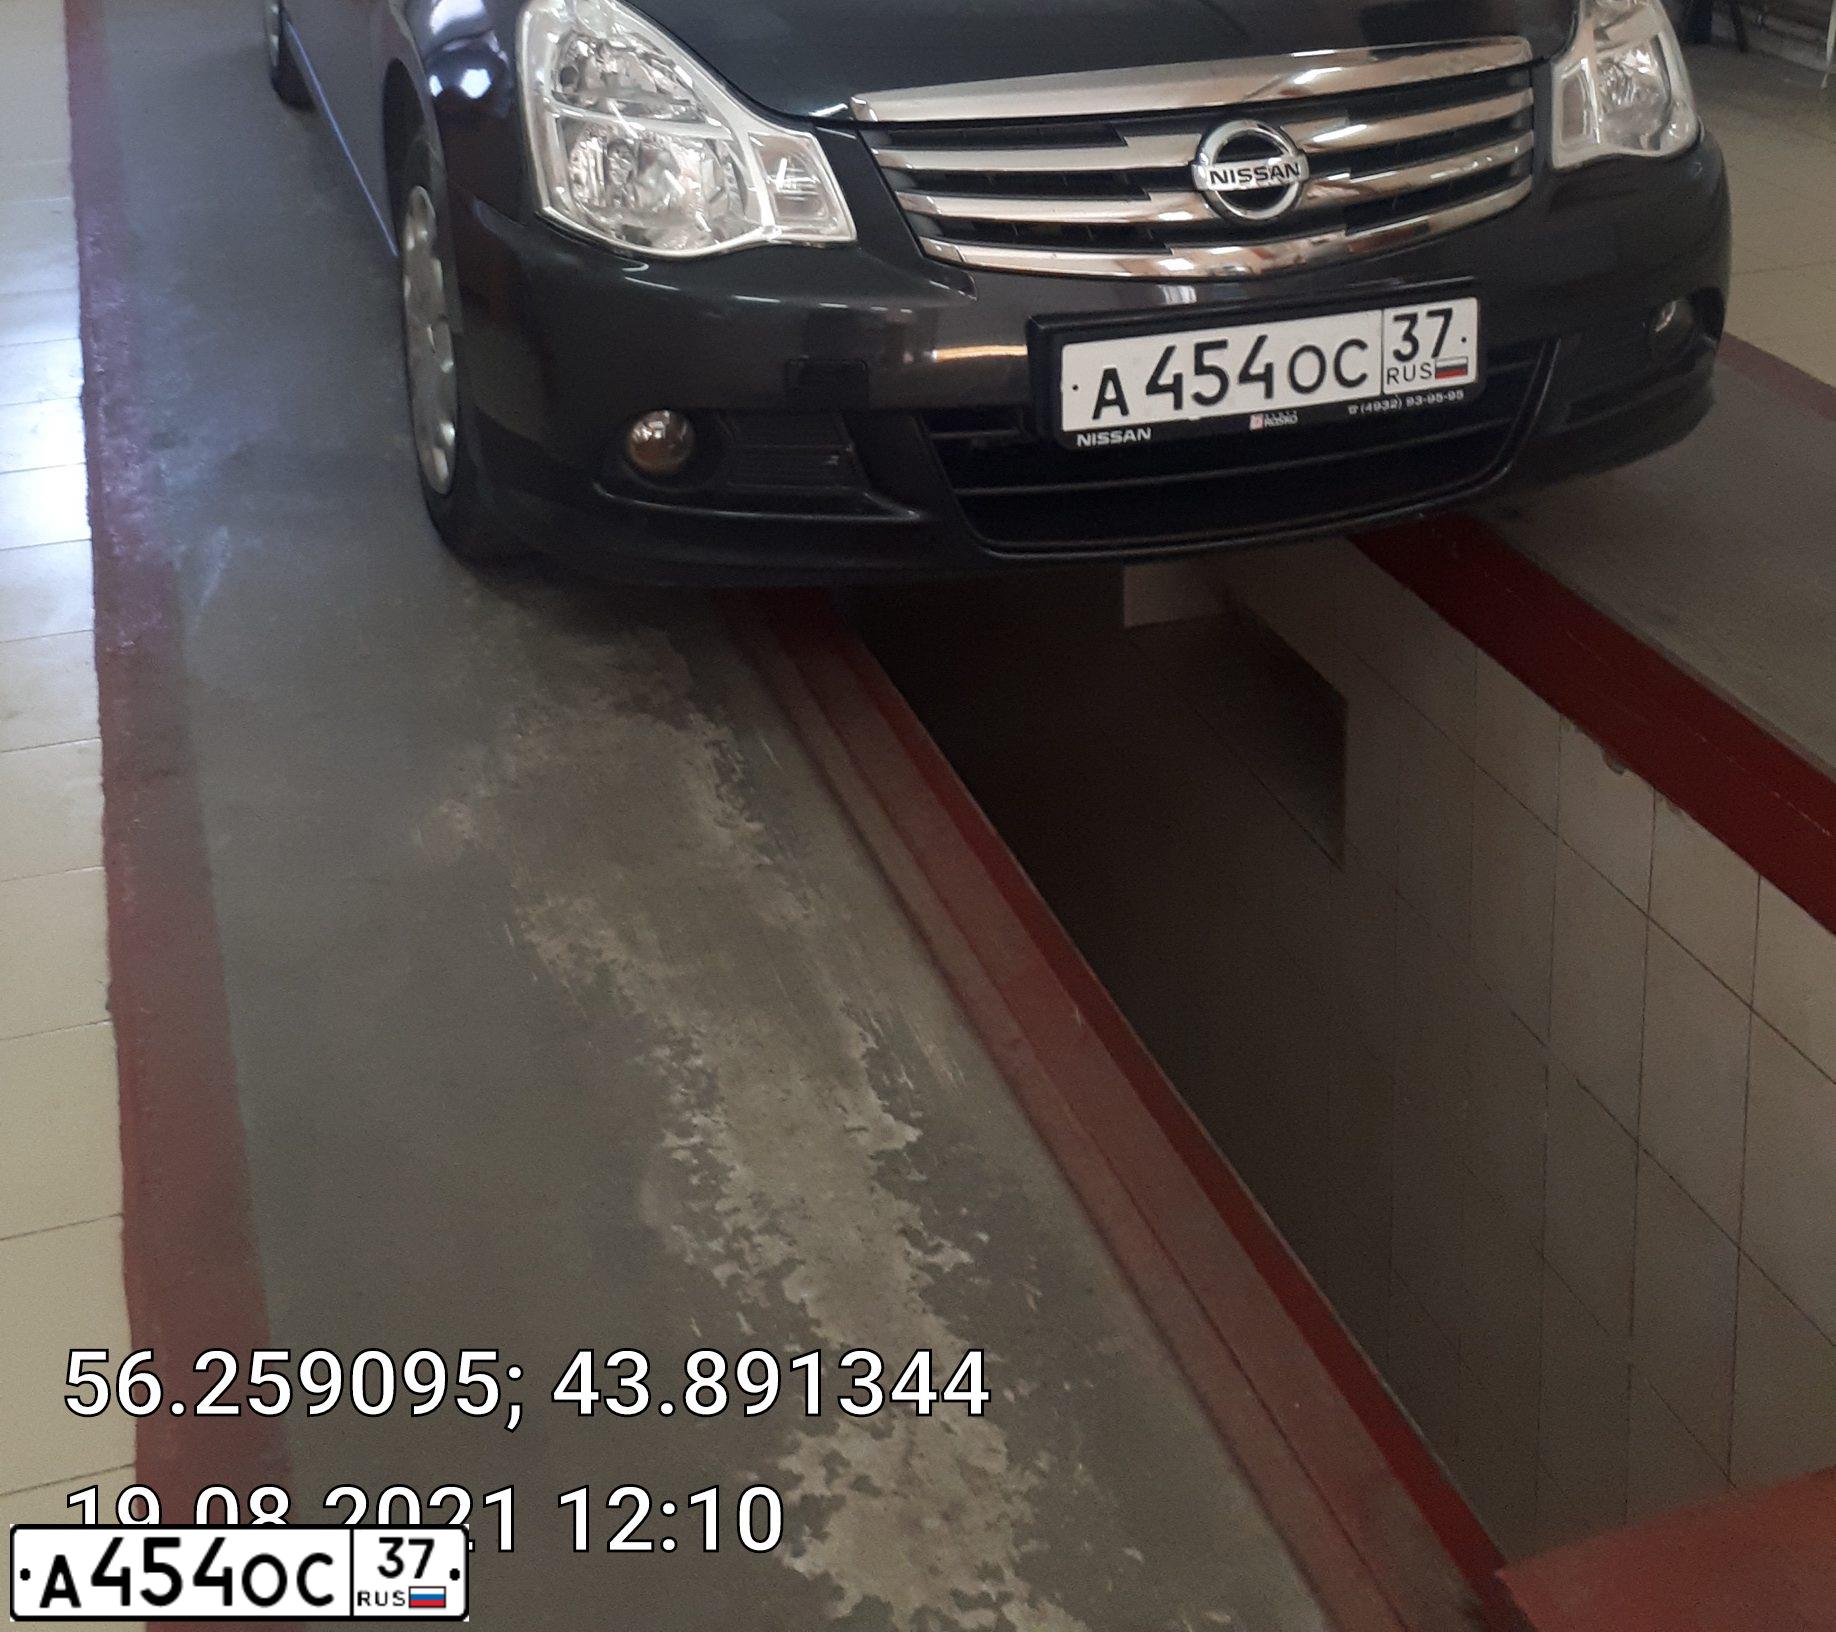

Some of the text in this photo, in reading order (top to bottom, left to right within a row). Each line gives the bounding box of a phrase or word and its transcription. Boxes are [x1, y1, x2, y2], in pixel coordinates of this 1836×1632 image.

[1208, 162, 1300, 185] NISSAN
[1392, 307, 1453, 363] 37
[1386, 362, 1433, 386] RUS
[1076, 426, 1152, 448] NISSAN
